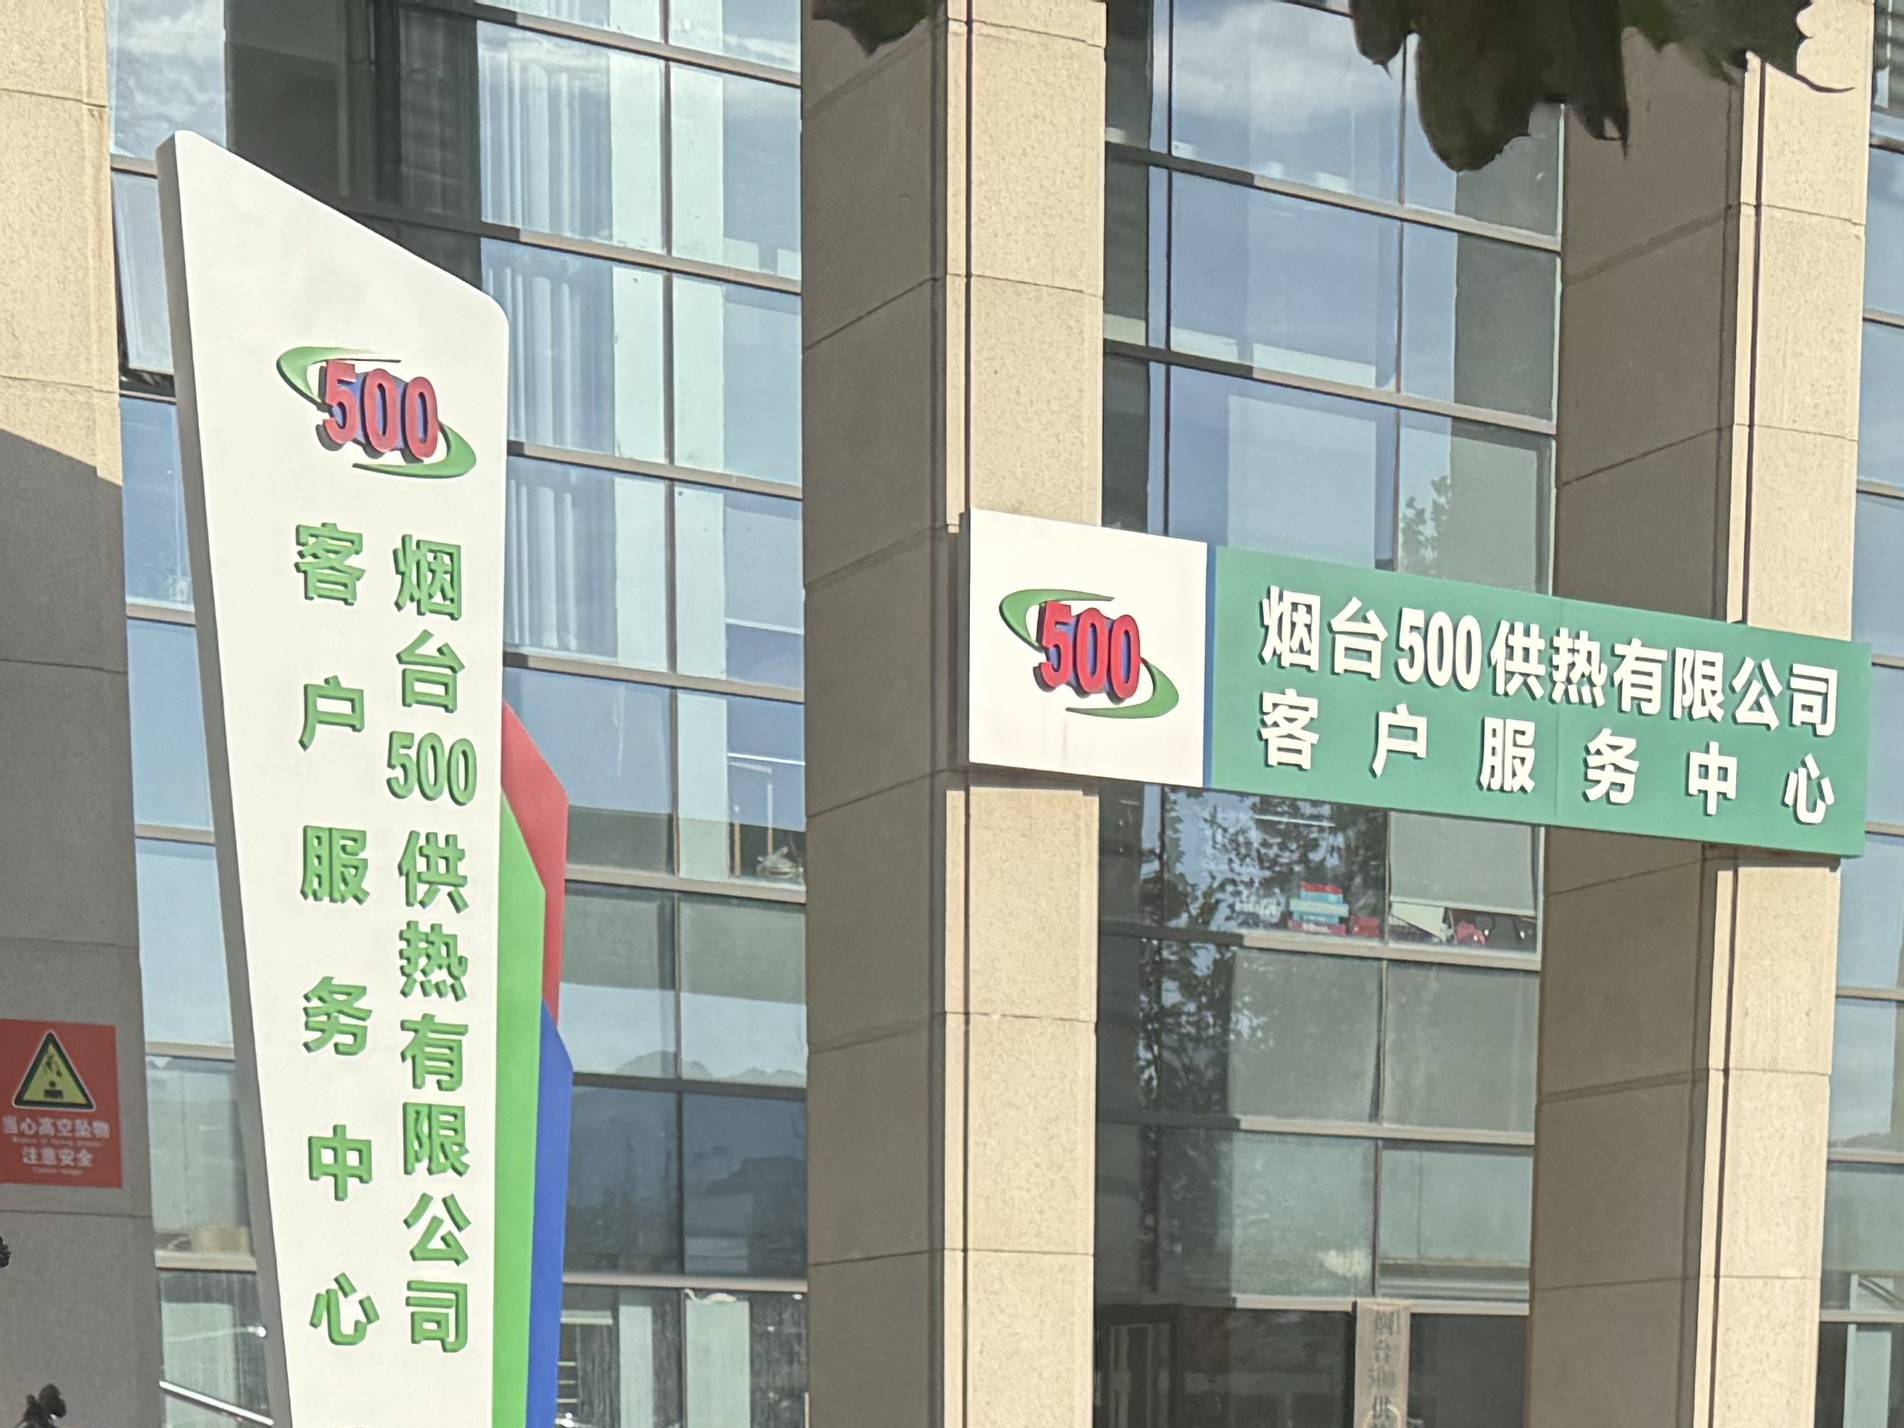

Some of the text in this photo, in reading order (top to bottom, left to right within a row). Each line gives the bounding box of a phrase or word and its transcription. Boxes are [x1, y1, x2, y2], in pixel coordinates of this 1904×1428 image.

[321, 359, 439, 462] 500
[1034, 600, 1142, 703] 500
[1259, 585, 1839, 737] 烟台500供热有限公司
[1259, 688, 1836, 826] 客户服务中心
[293, 521, 380, 1347] 客户服务中心
[387, 533, 477, 1353] 烟台500供热有限公司
